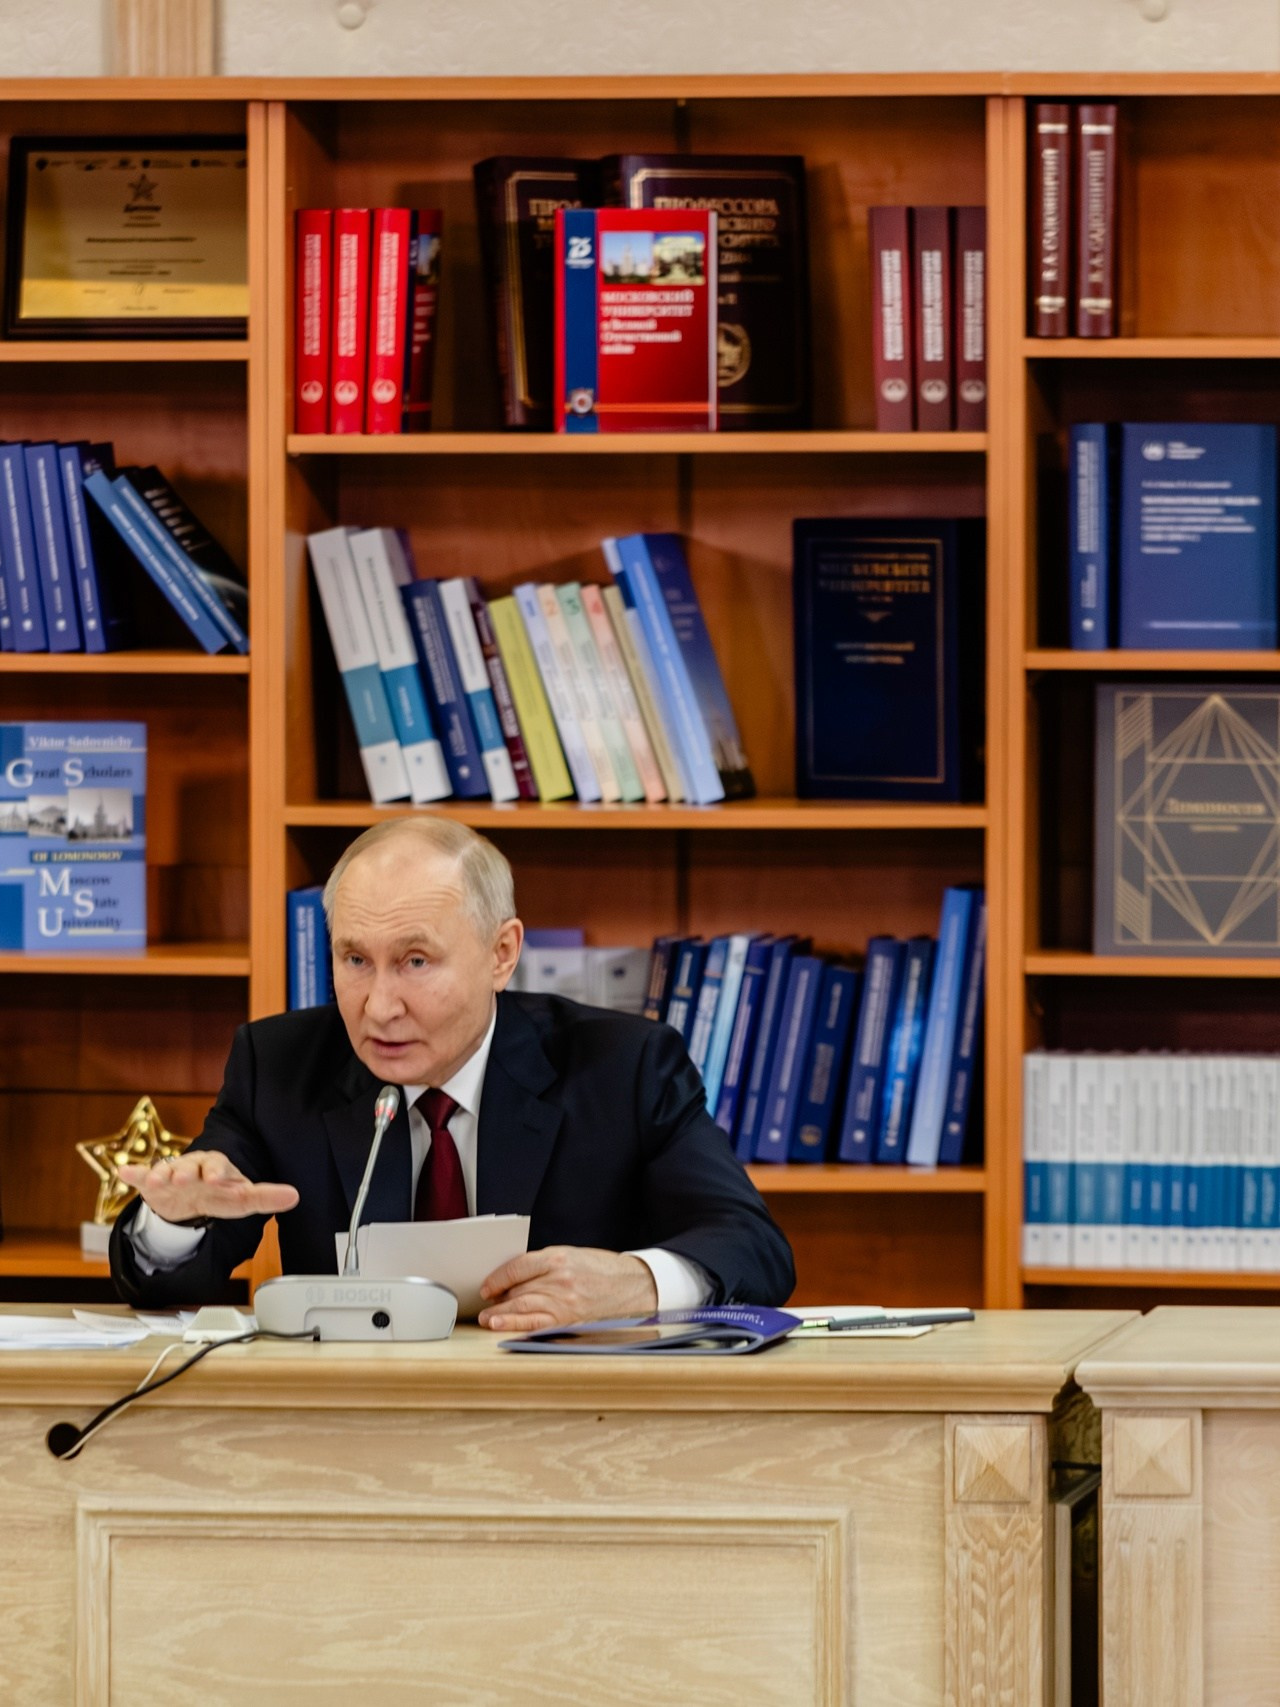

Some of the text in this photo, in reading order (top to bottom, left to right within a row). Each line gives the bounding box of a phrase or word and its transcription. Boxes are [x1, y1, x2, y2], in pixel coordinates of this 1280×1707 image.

[29, 735, 133, 751] Viktor Sadovnichy
[5, 758, 133, 788] Great Scholars
[39, 867, 111, 897] Moscow
[73, 888, 118, 918] State
[37, 907, 122, 937] University
[332, 1287, 392, 1303] BOSCH
